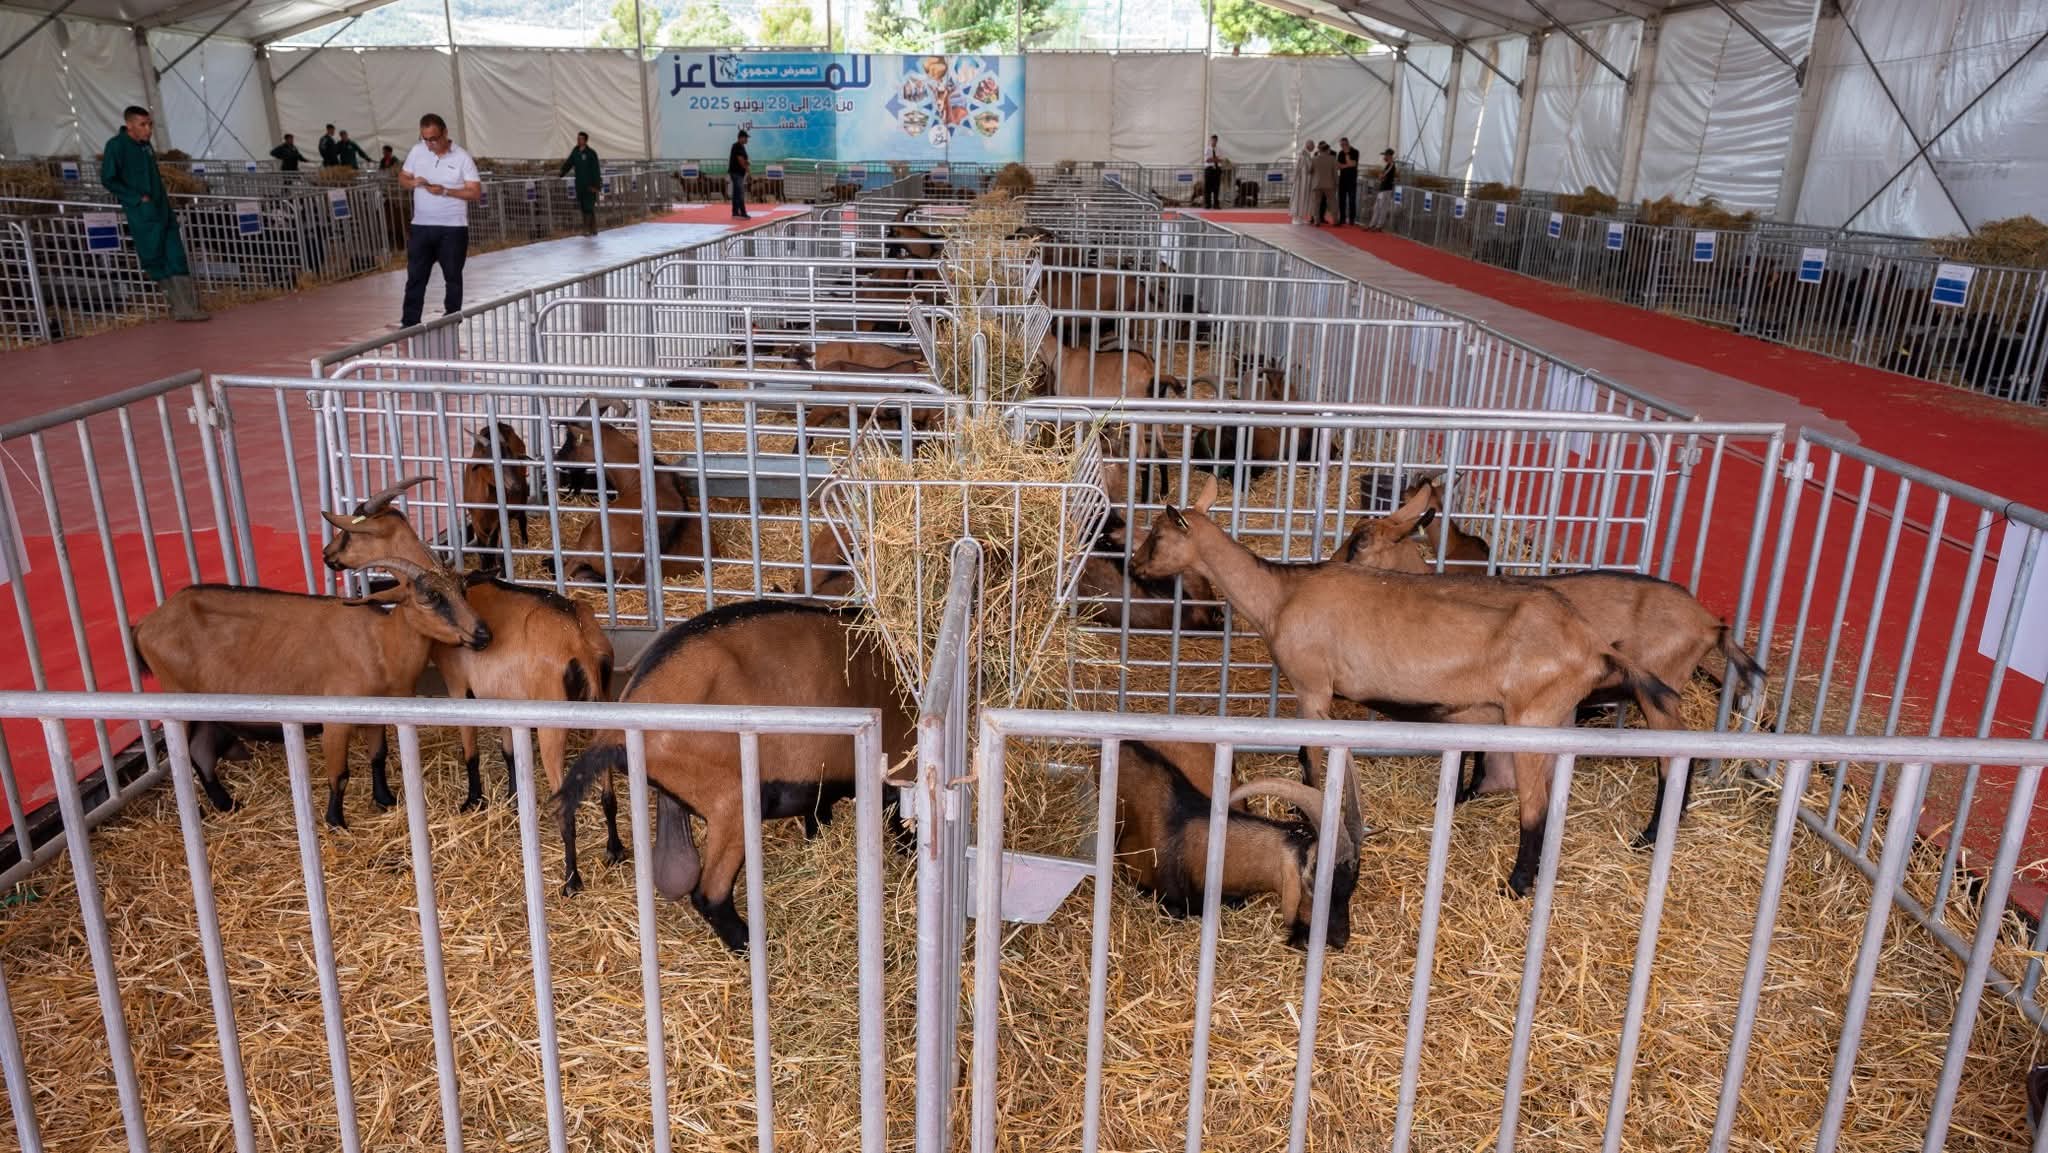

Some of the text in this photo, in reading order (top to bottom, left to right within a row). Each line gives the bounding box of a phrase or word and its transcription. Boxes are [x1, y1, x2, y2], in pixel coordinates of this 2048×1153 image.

[740, 66, 818, 79] المعرض الجهوي
[689, 96, 730, 110] 2025
[733, 98, 764, 113] يونيو
[768, 96, 787, 110] 28
[812, 97, 832, 110] 24
[835, 99, 854, 112] من
